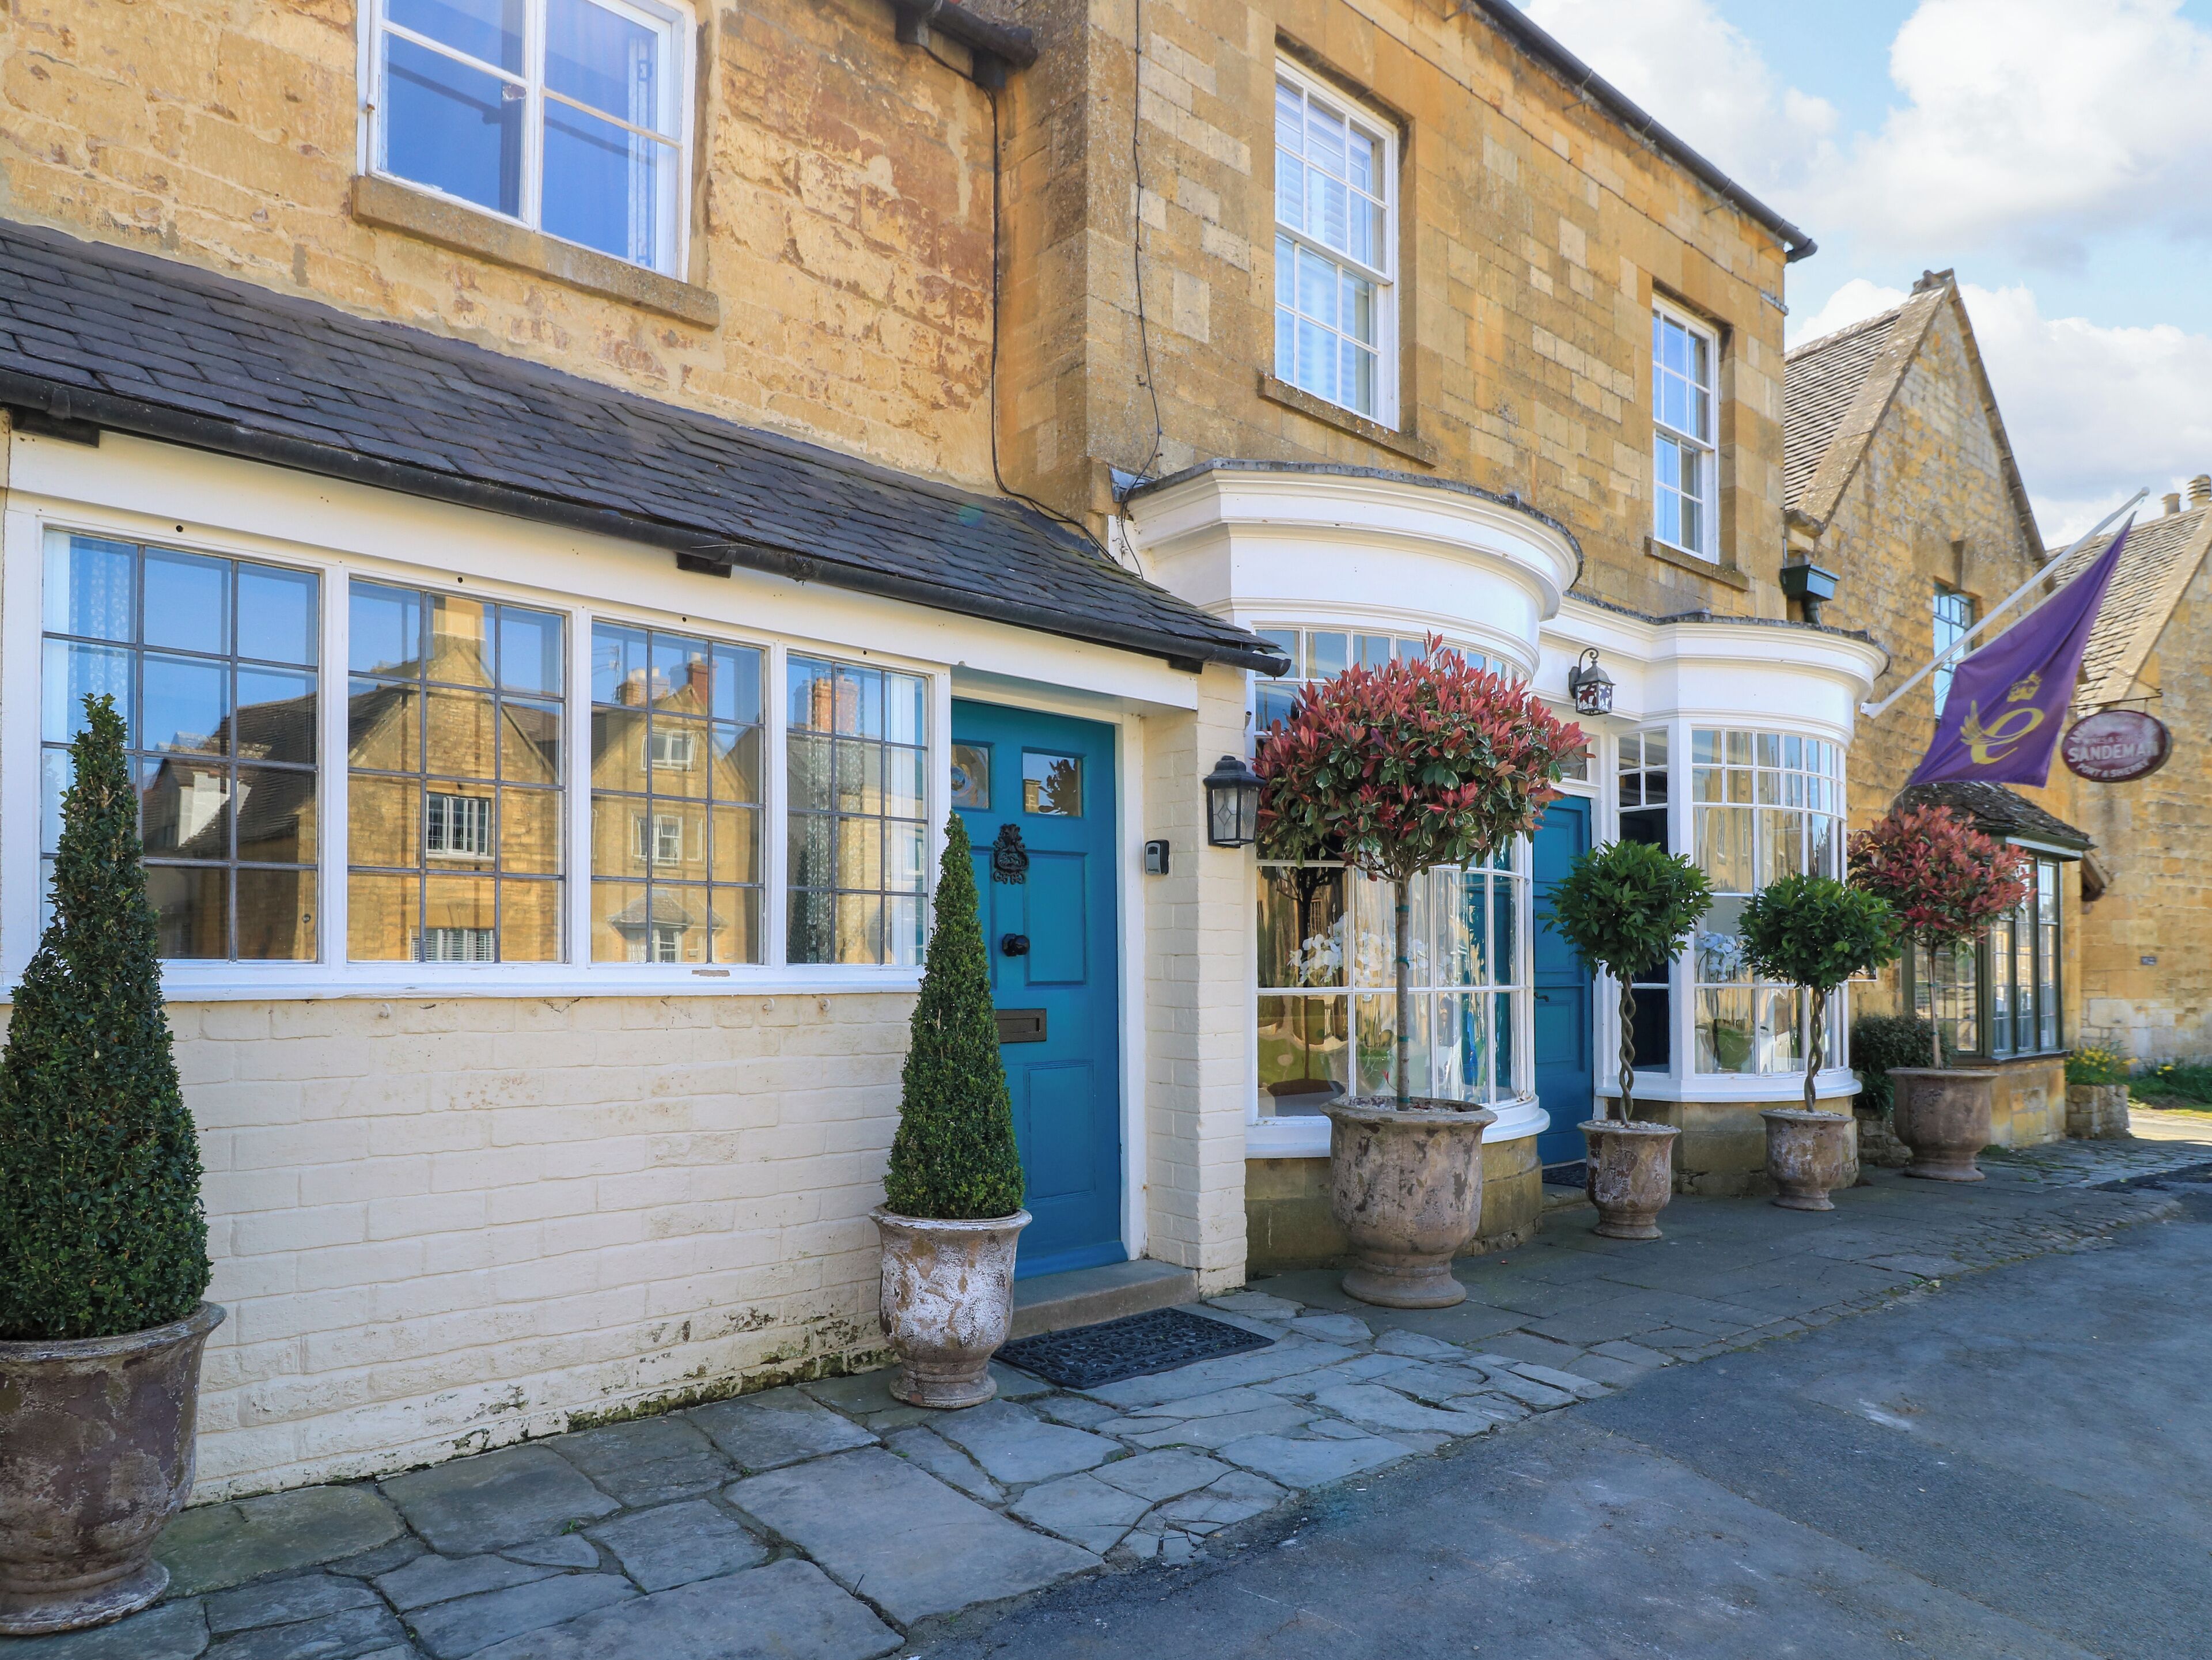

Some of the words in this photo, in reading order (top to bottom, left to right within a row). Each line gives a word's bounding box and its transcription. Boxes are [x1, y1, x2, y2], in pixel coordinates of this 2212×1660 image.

[2067, 742, 2158, 763] SANDEMA
[2076, 763, 2102, 776] PORT
[2110, 759, 2149, 777] SHERRY
